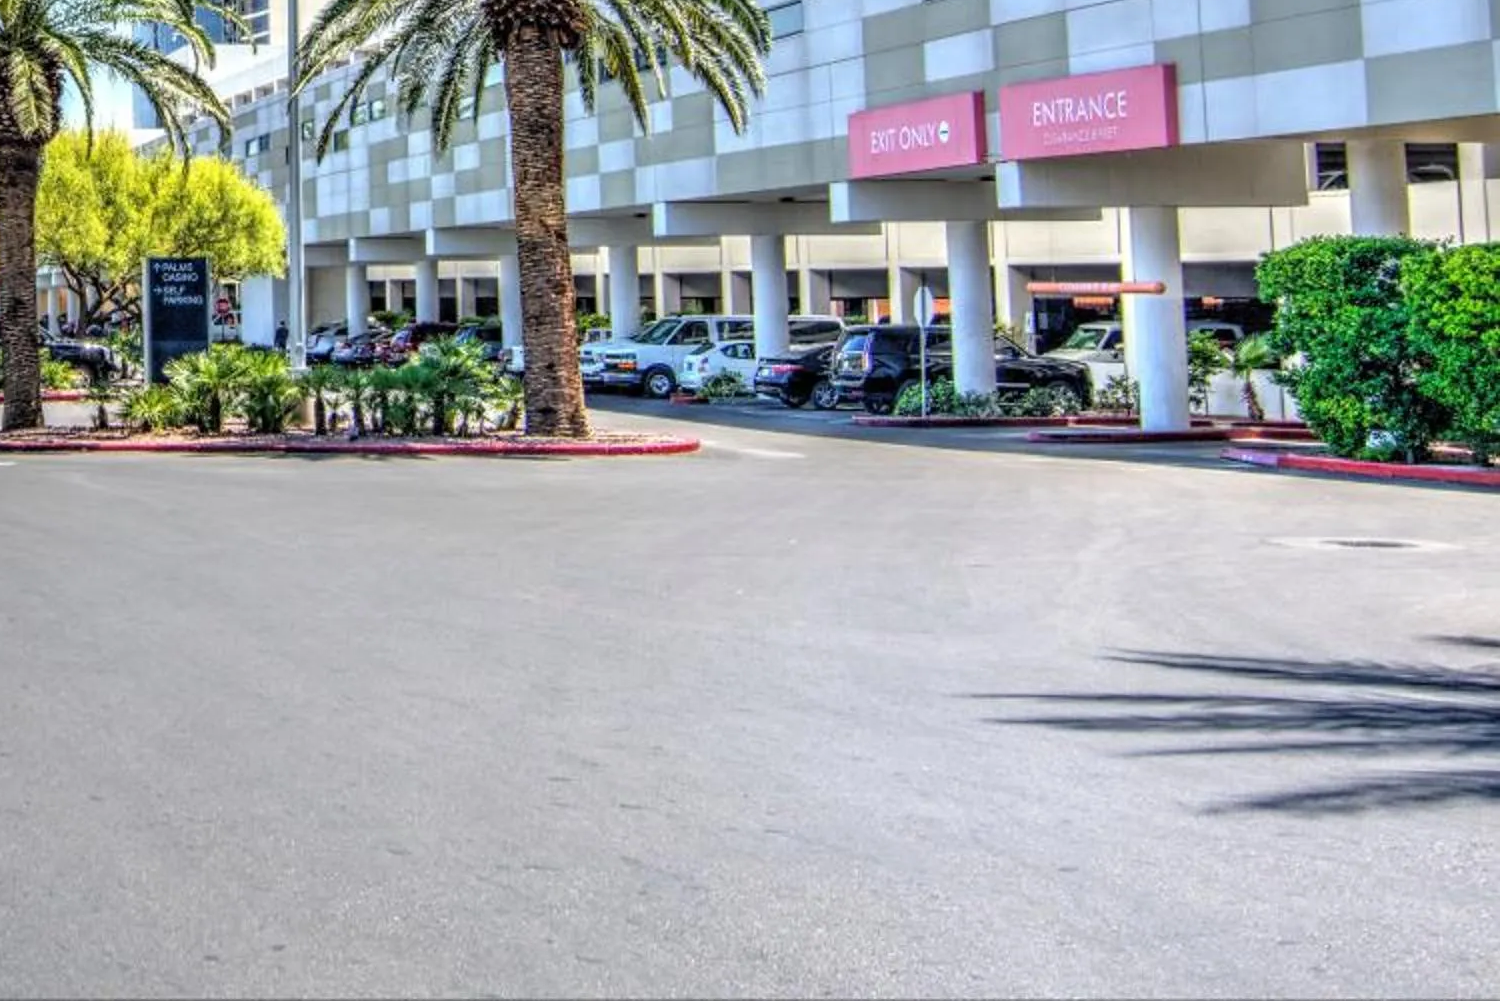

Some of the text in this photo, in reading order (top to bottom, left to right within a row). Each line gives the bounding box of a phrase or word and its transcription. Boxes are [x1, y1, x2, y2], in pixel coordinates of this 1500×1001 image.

[1033, 89, 1127, 128] ENTRANCE
[870, 123, 937, 154] EXIT ONLY
[163, 272, 199, 282] CASINO
